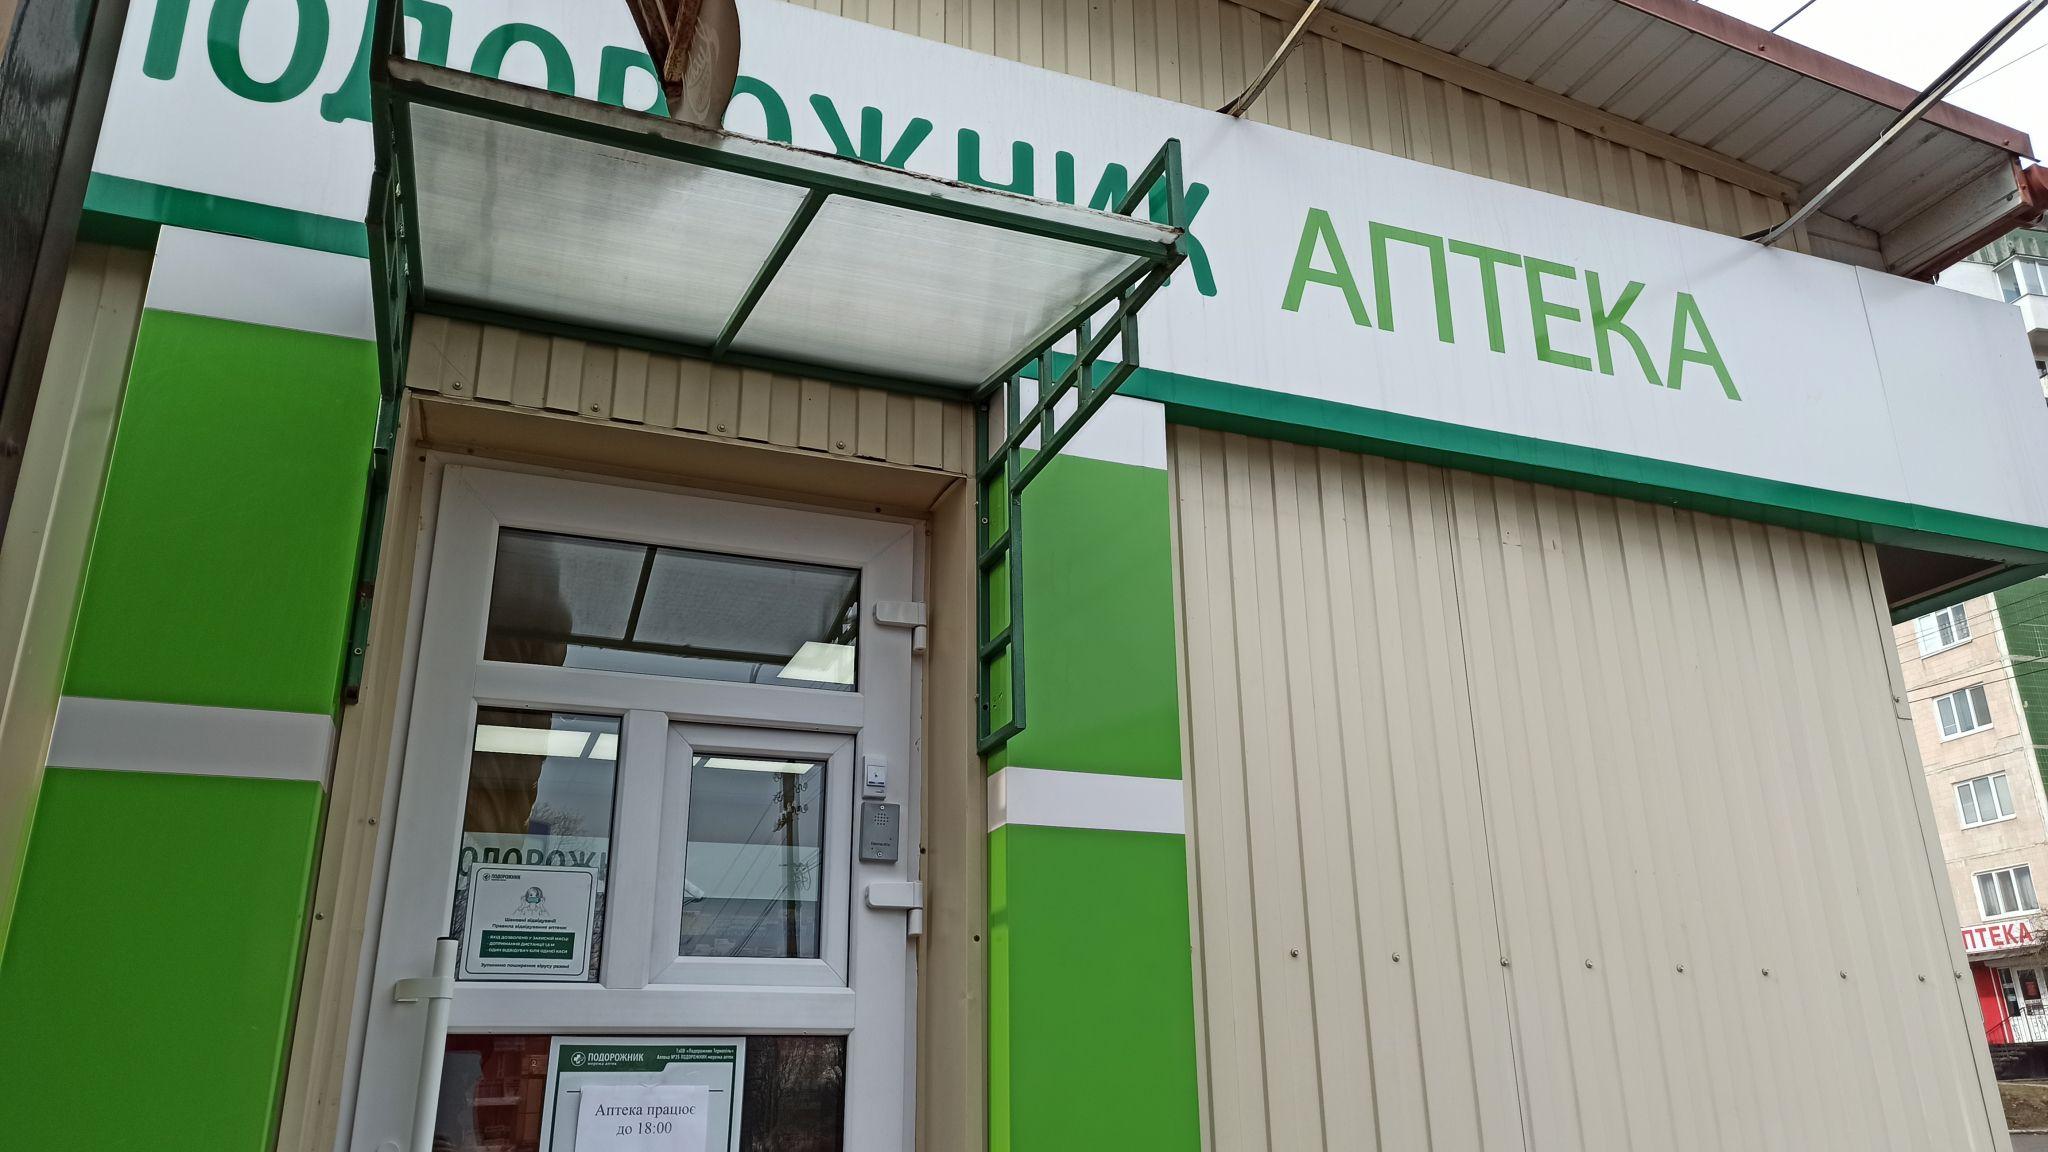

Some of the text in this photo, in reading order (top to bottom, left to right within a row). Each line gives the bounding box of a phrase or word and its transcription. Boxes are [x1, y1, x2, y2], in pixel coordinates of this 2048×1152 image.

[143, 0, 1742, 401] ОДОРОЖНИК АПТЕКА
[587, 1052, 644, 1062] ПОДОРОЖНИК
[594, 1104, 696, 1117] Аптека працює
[616, 1121, 672, 1136] до 18:00
